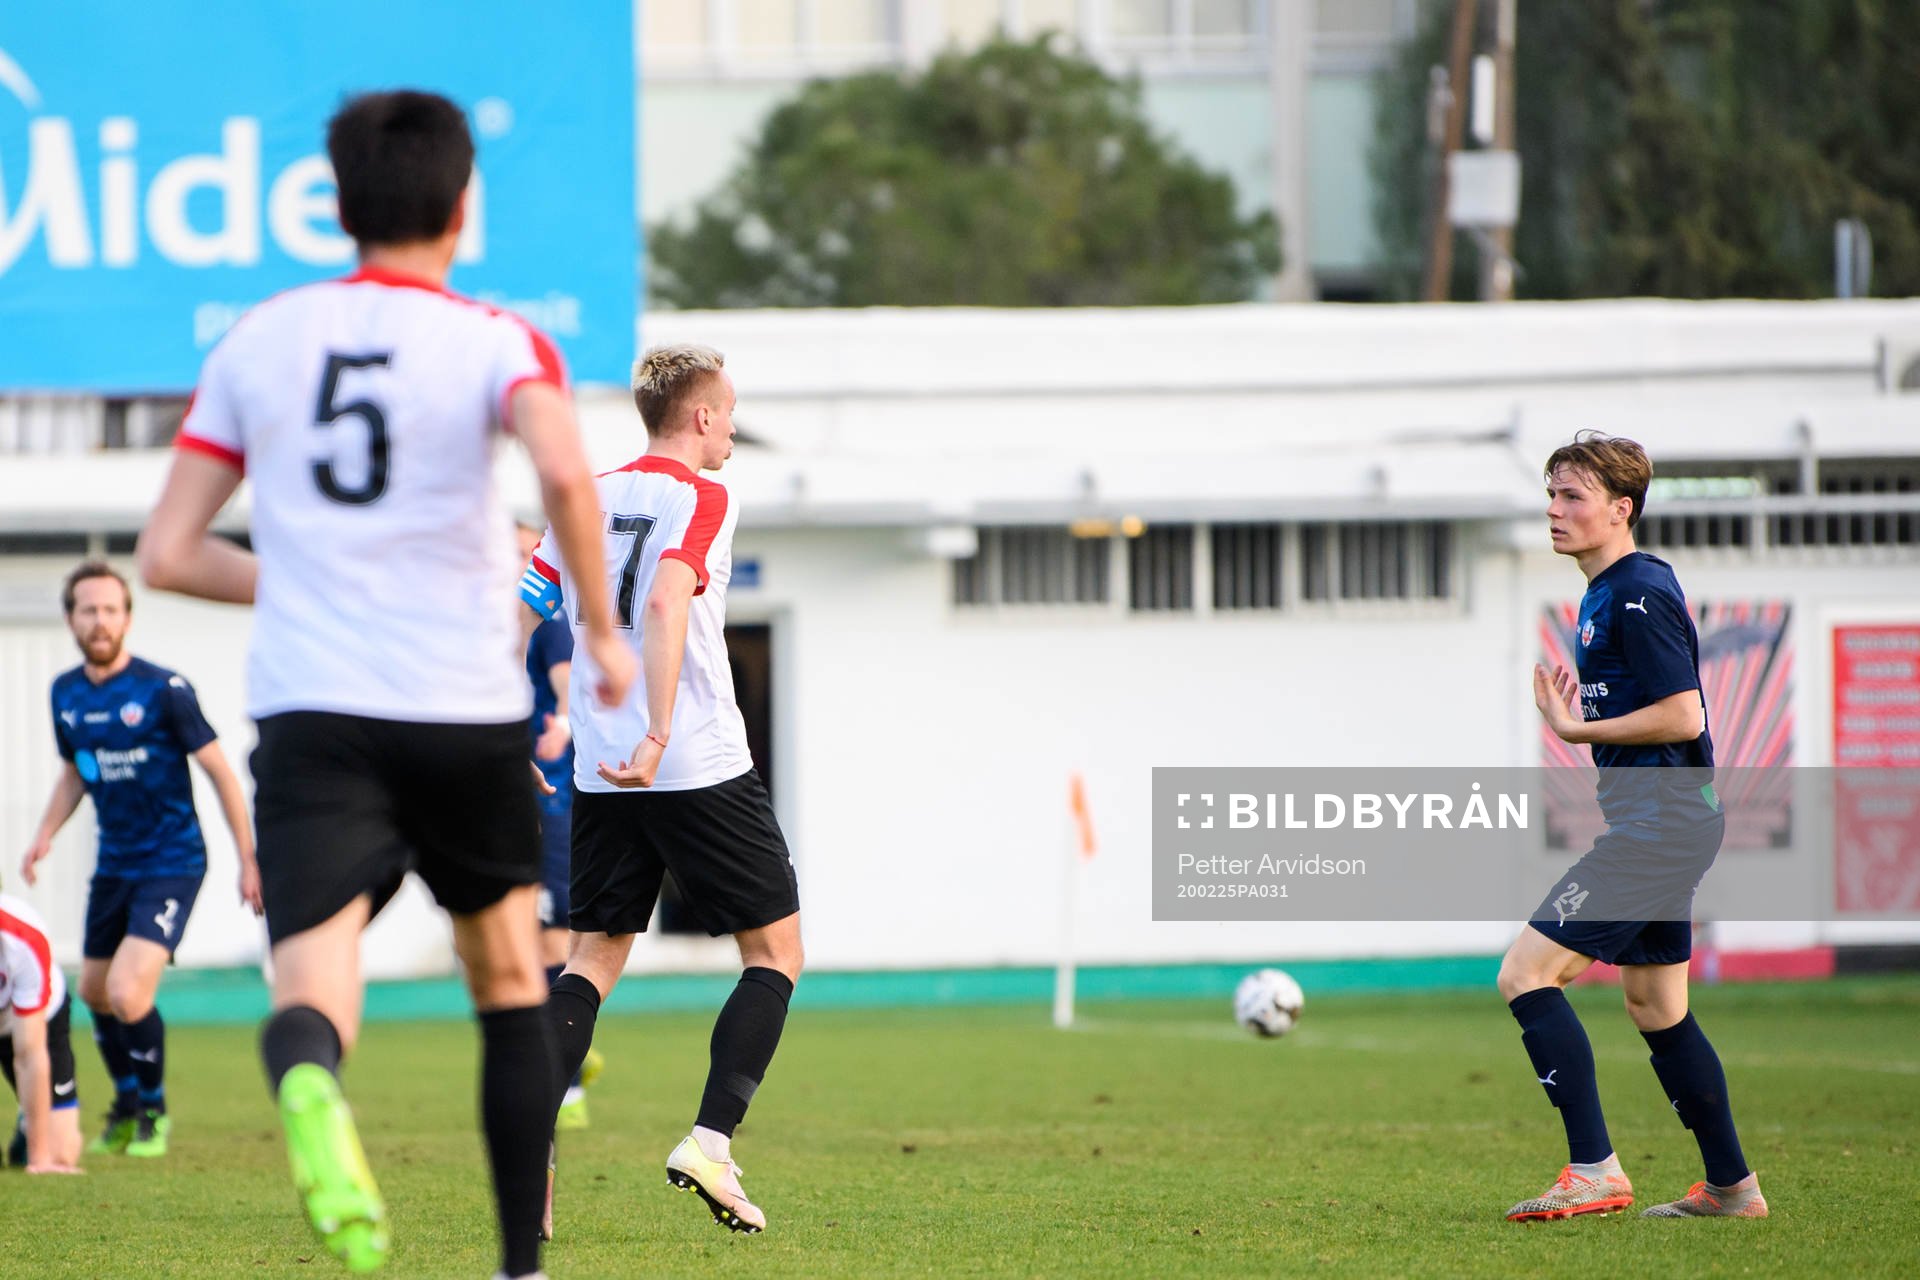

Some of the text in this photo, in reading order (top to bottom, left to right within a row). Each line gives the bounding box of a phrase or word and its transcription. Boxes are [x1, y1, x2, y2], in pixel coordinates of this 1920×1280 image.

[0, 115, 488, 269] Mide
[311, 352, 392, 506] 5
[1558, 882, 1590, 911] 24
